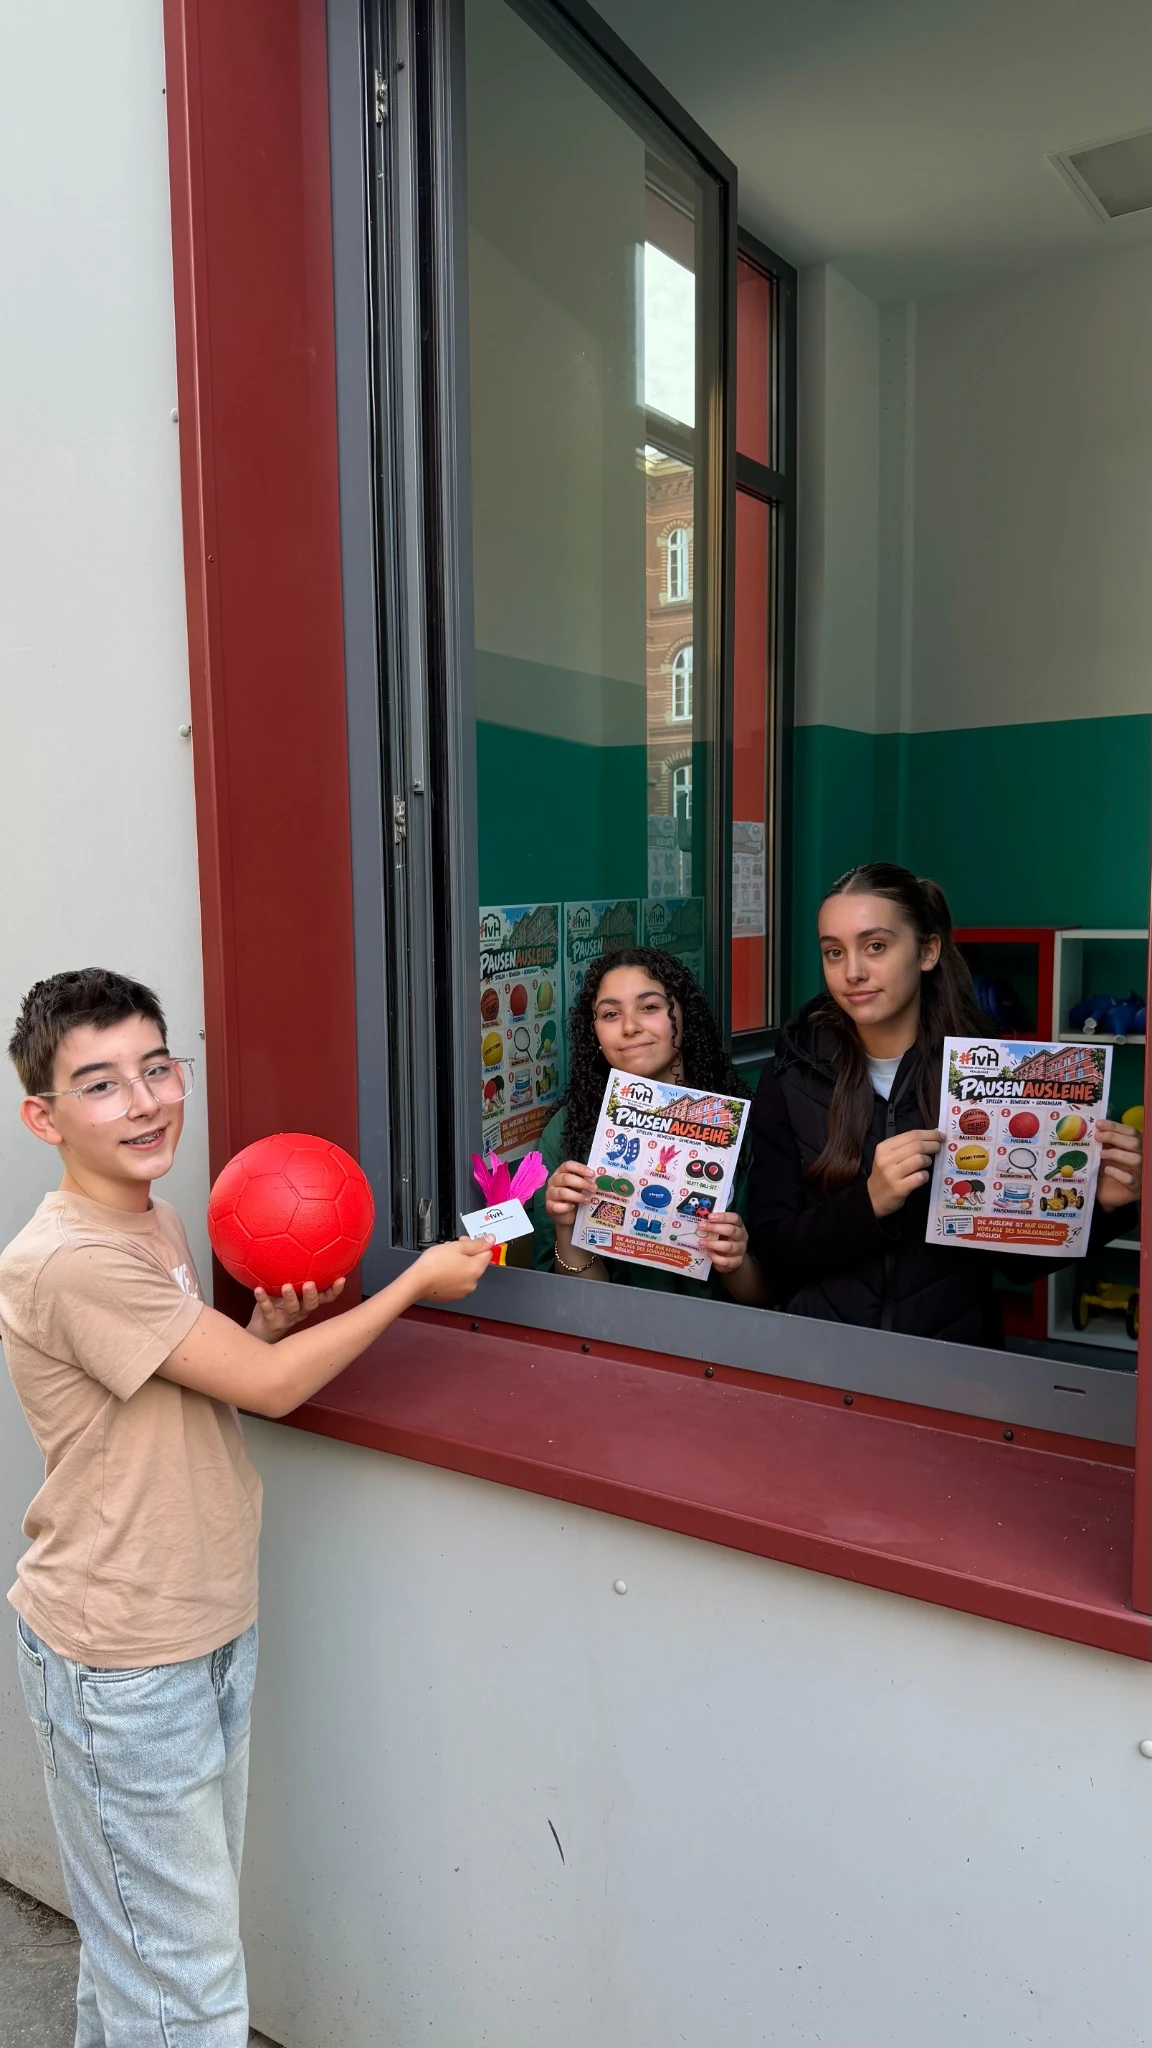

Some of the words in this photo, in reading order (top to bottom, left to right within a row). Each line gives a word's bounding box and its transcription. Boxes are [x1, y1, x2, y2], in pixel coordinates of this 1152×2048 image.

[649, 932, 671, 947] REGELN
[480, 946, 554, 979] PAUSENAUSLEIHE
[959, 1052, 998, 1066] #IvH
[620, 1085, 652, 1103] #IvH
[959, 1077, 1095, 1100] PAUSENAUSLEIHE
[615, 1107, 731, 1146] PAUSENAUSLEIHE
[636, 1129, 653, 1137] SPIELEN
[656, 1133, 675, 1141] BEWEGEN
[1016, 1228, 1066, 1237] SCHÜLERAUSWEISES
[615, 1241, 635, 1250] VORLAGE
[625, 1238, 646, 1247] AUSLEIHE
